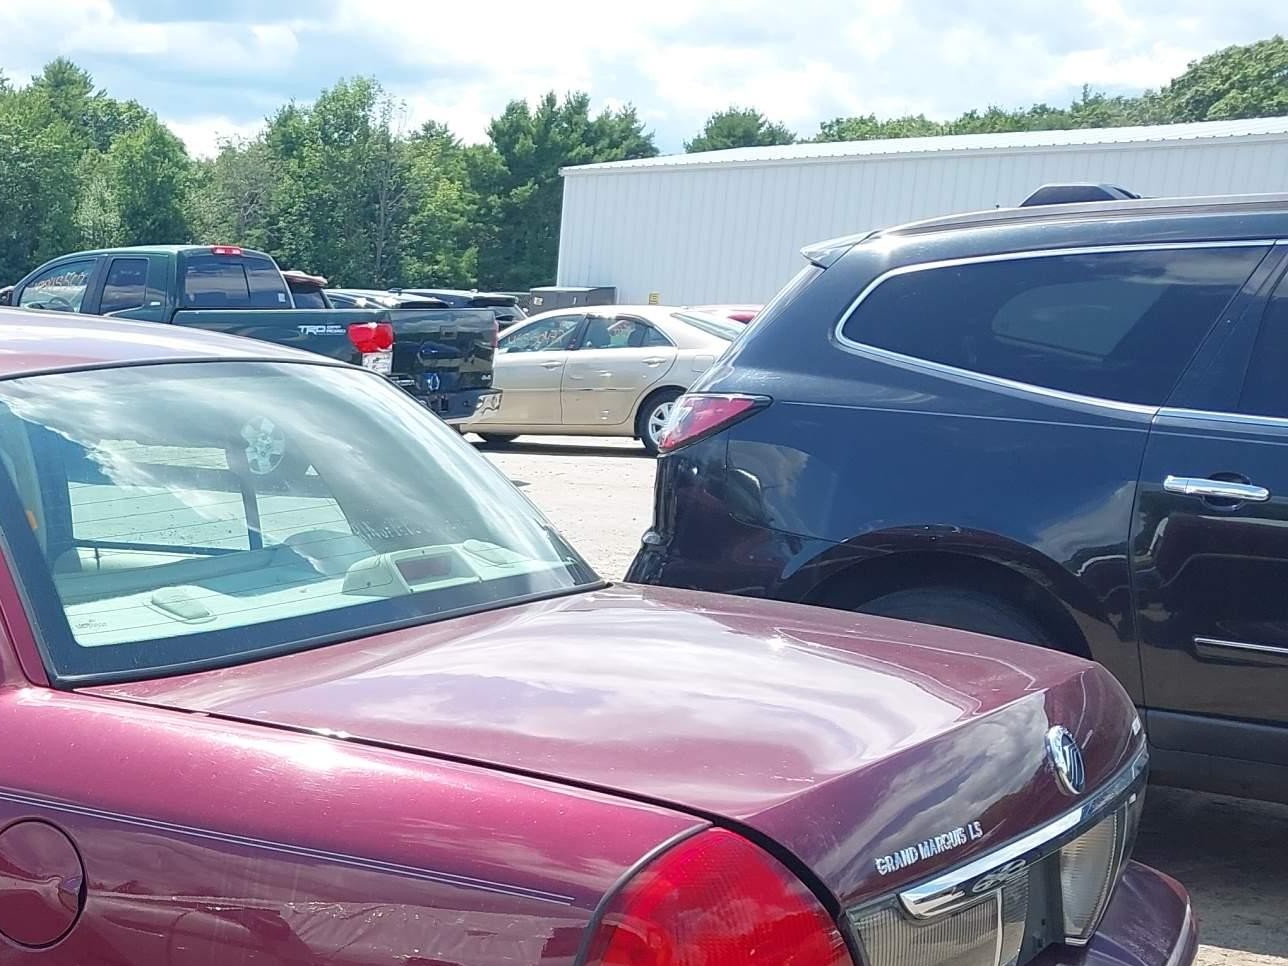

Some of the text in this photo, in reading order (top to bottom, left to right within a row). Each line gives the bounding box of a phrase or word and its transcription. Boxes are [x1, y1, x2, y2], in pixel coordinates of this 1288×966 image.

[875, 820, 984, 876] GRAND MARQUIS LS
